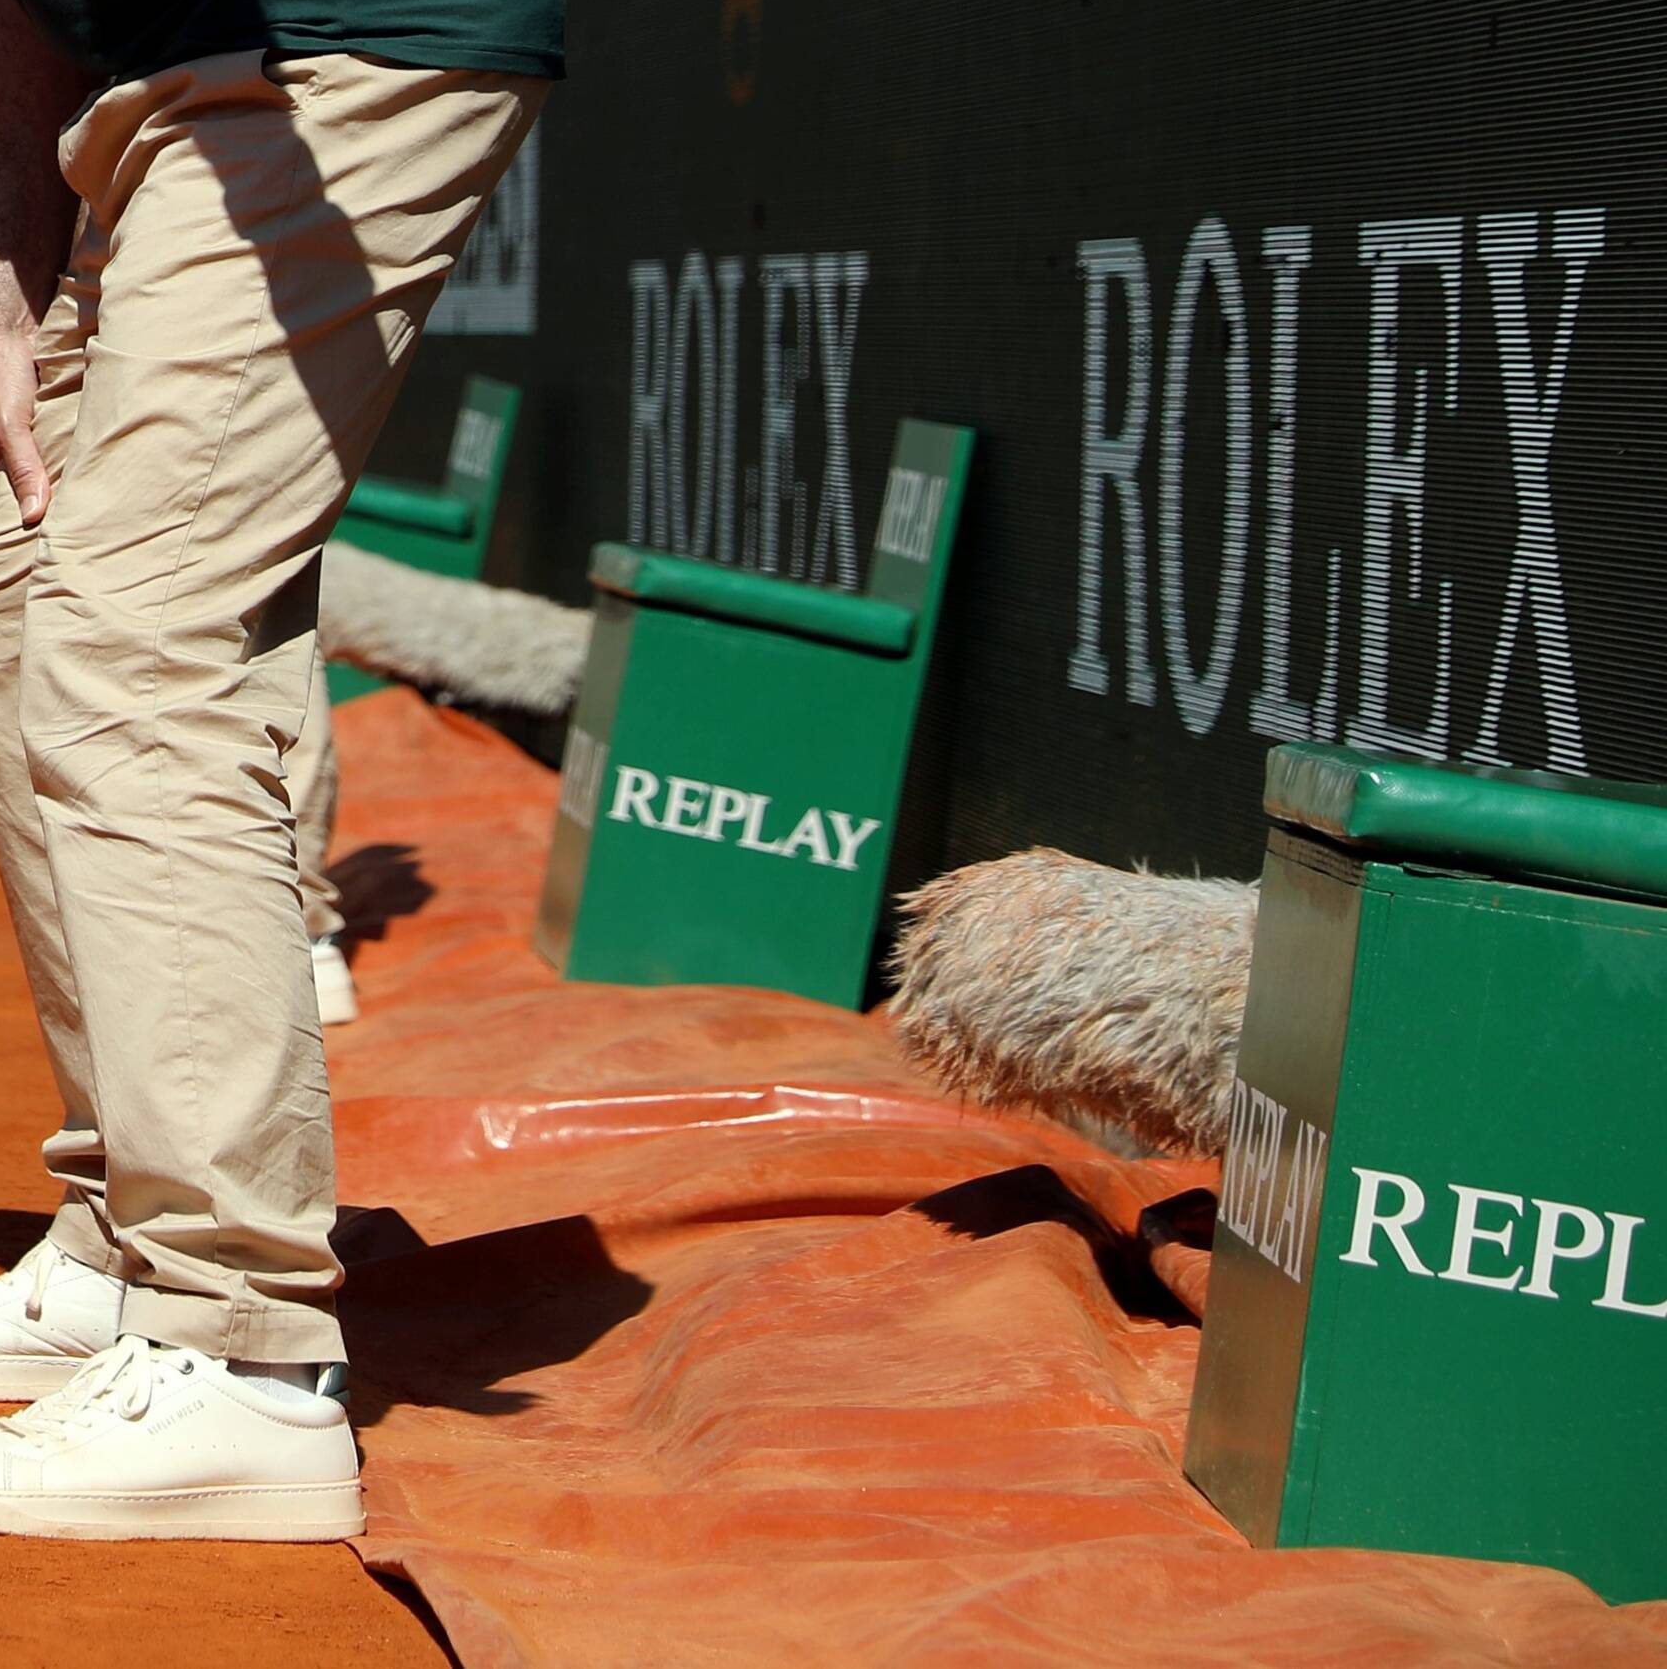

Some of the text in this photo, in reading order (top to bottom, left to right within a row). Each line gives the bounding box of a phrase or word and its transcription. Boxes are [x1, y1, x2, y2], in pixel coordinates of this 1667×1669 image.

[628, 249, 869, 591] ROLEX
[1067, 207, 1607, 777] ROLEX
[606, 765, 882, 871] REPLAY
[1217, 1077, 1328, 1284] REPLAY
[1338, 1166, 1667, 1319] REPL
